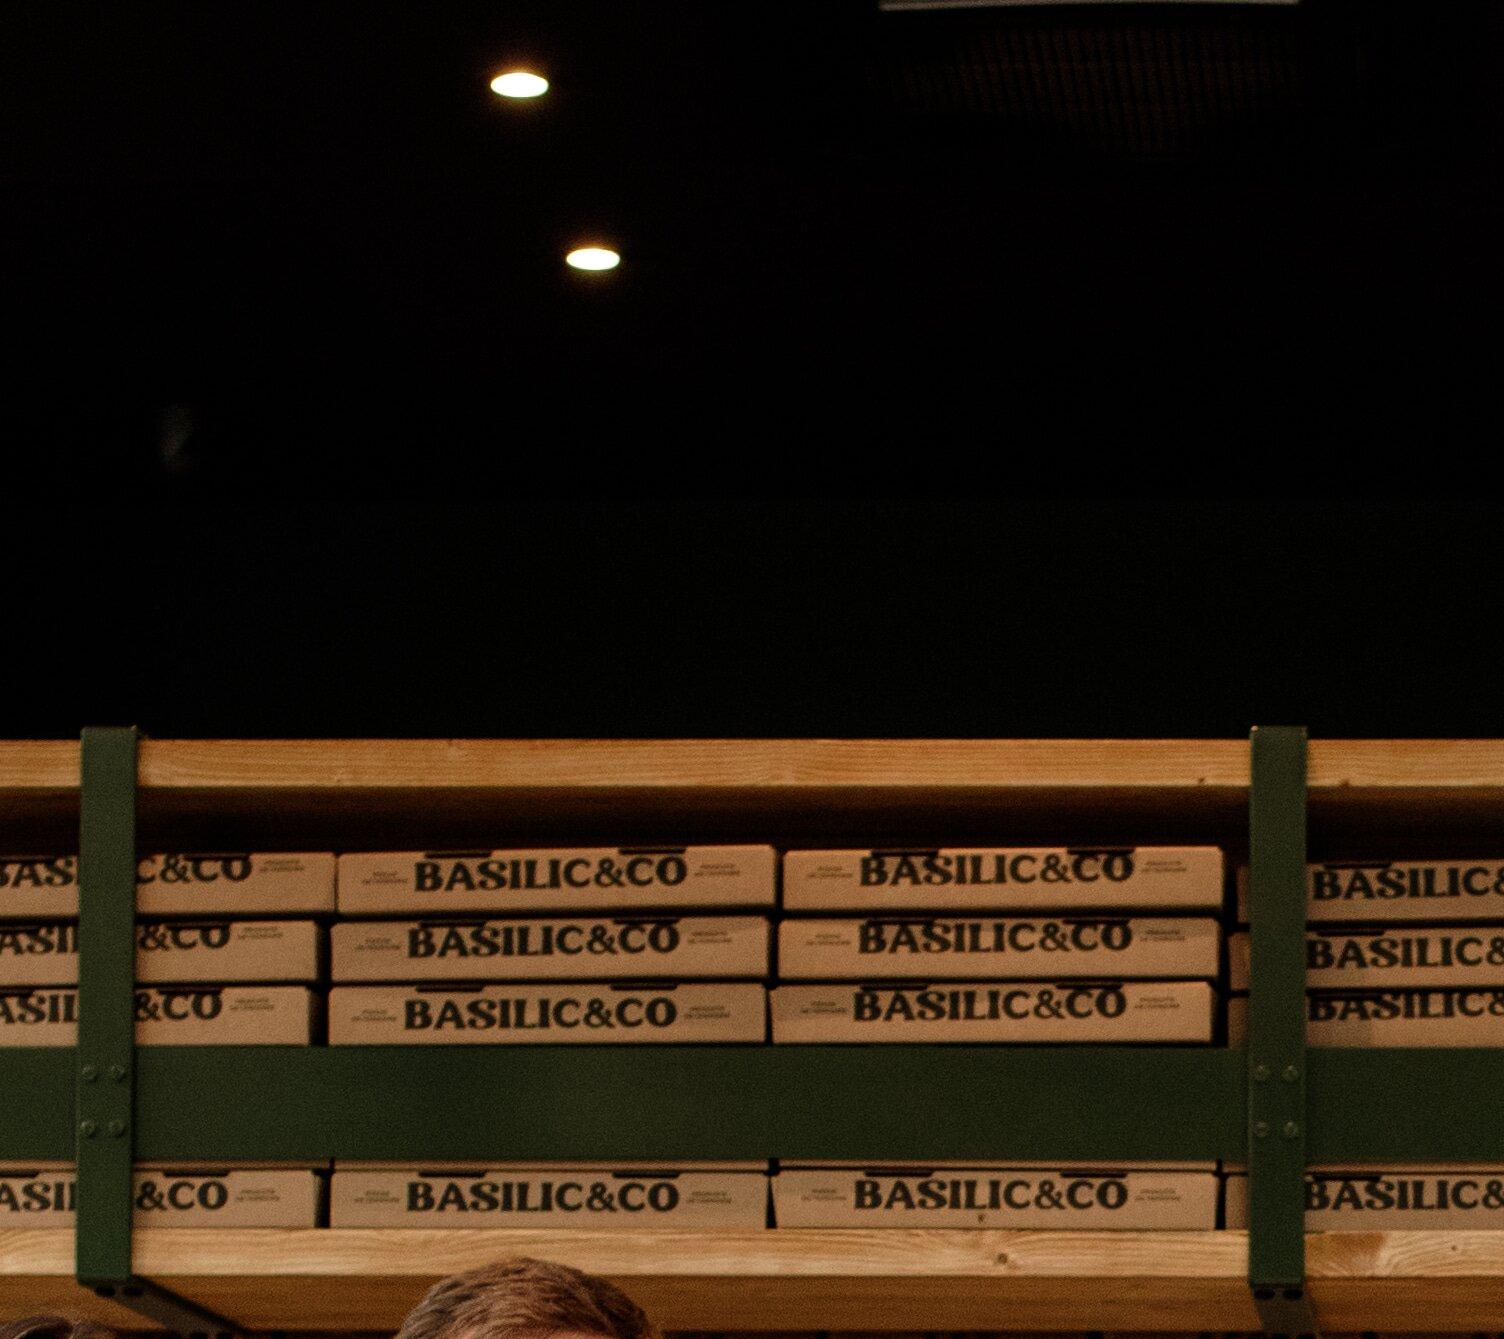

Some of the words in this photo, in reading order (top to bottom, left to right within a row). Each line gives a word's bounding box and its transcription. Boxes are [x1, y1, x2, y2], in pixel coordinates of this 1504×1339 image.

[415, 855, 688, 891] BASILIC&CO
[860, 853, 1134, 887] BASILIC&CO
[407, 923, 679, 960] BASILIC&CO
[858, 920, 1132, 953] BASILIC&CO
[404, 998, 677, 1030] BASILIC&CO
[853, 989, 1127, 1022] BASILIC&CO
[407, 1179, 679, 1213] BASILIC&CO
[854, 1178, 1128, 1211] BASILIC&CO
